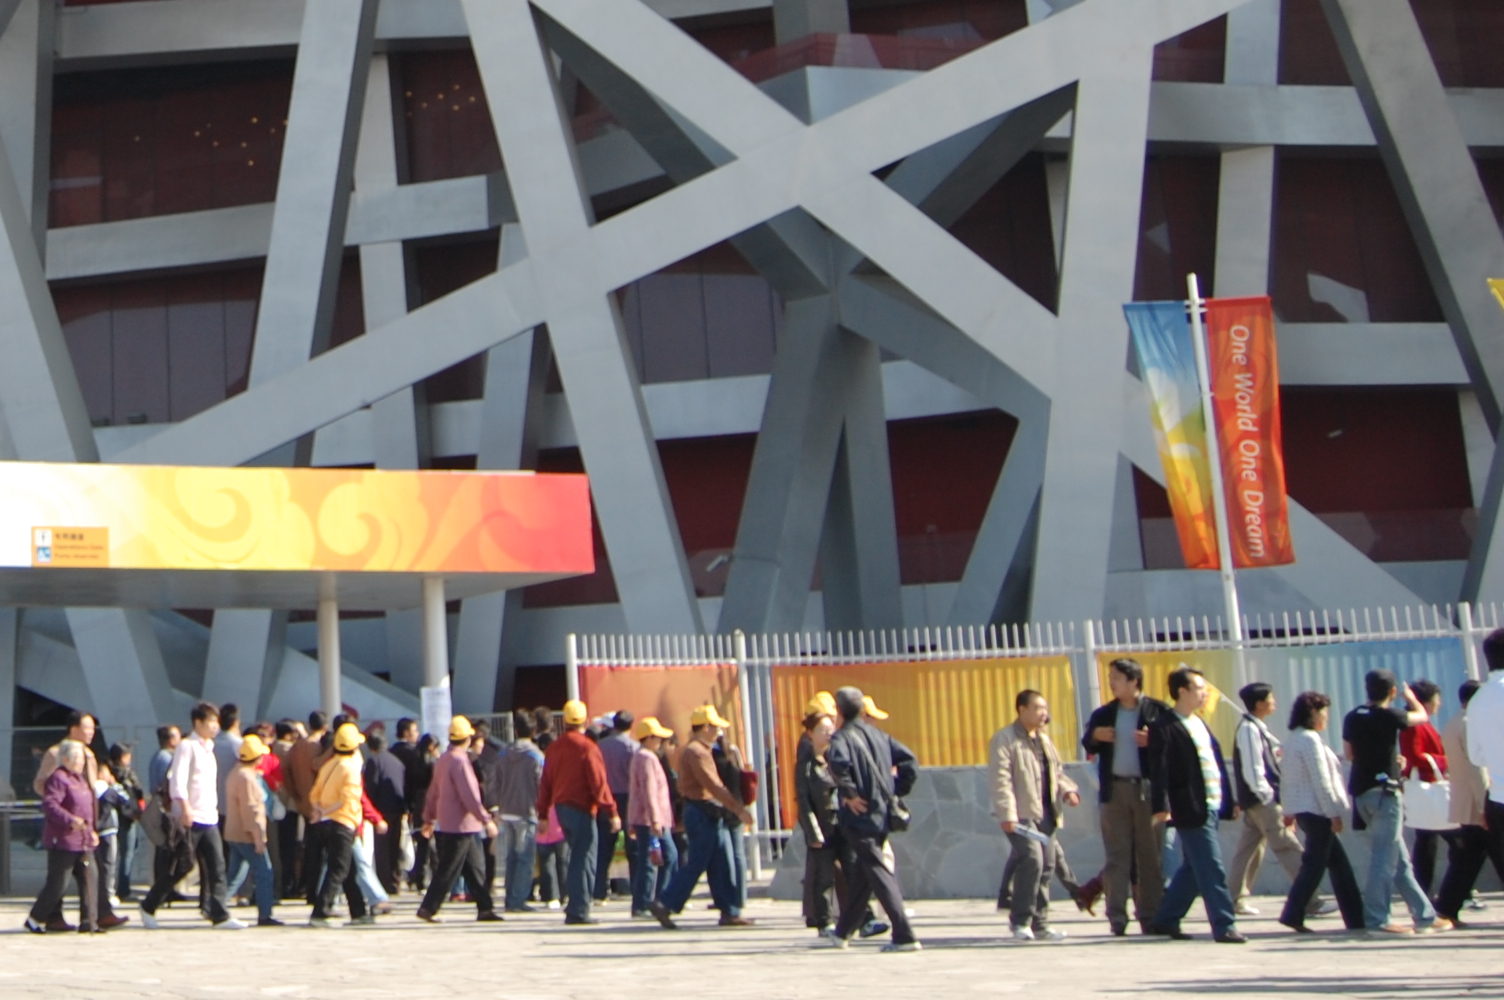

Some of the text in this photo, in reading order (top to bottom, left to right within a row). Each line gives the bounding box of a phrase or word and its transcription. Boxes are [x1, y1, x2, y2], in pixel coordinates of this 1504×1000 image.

[1229, 324, 1265, 558] One World One Dream
